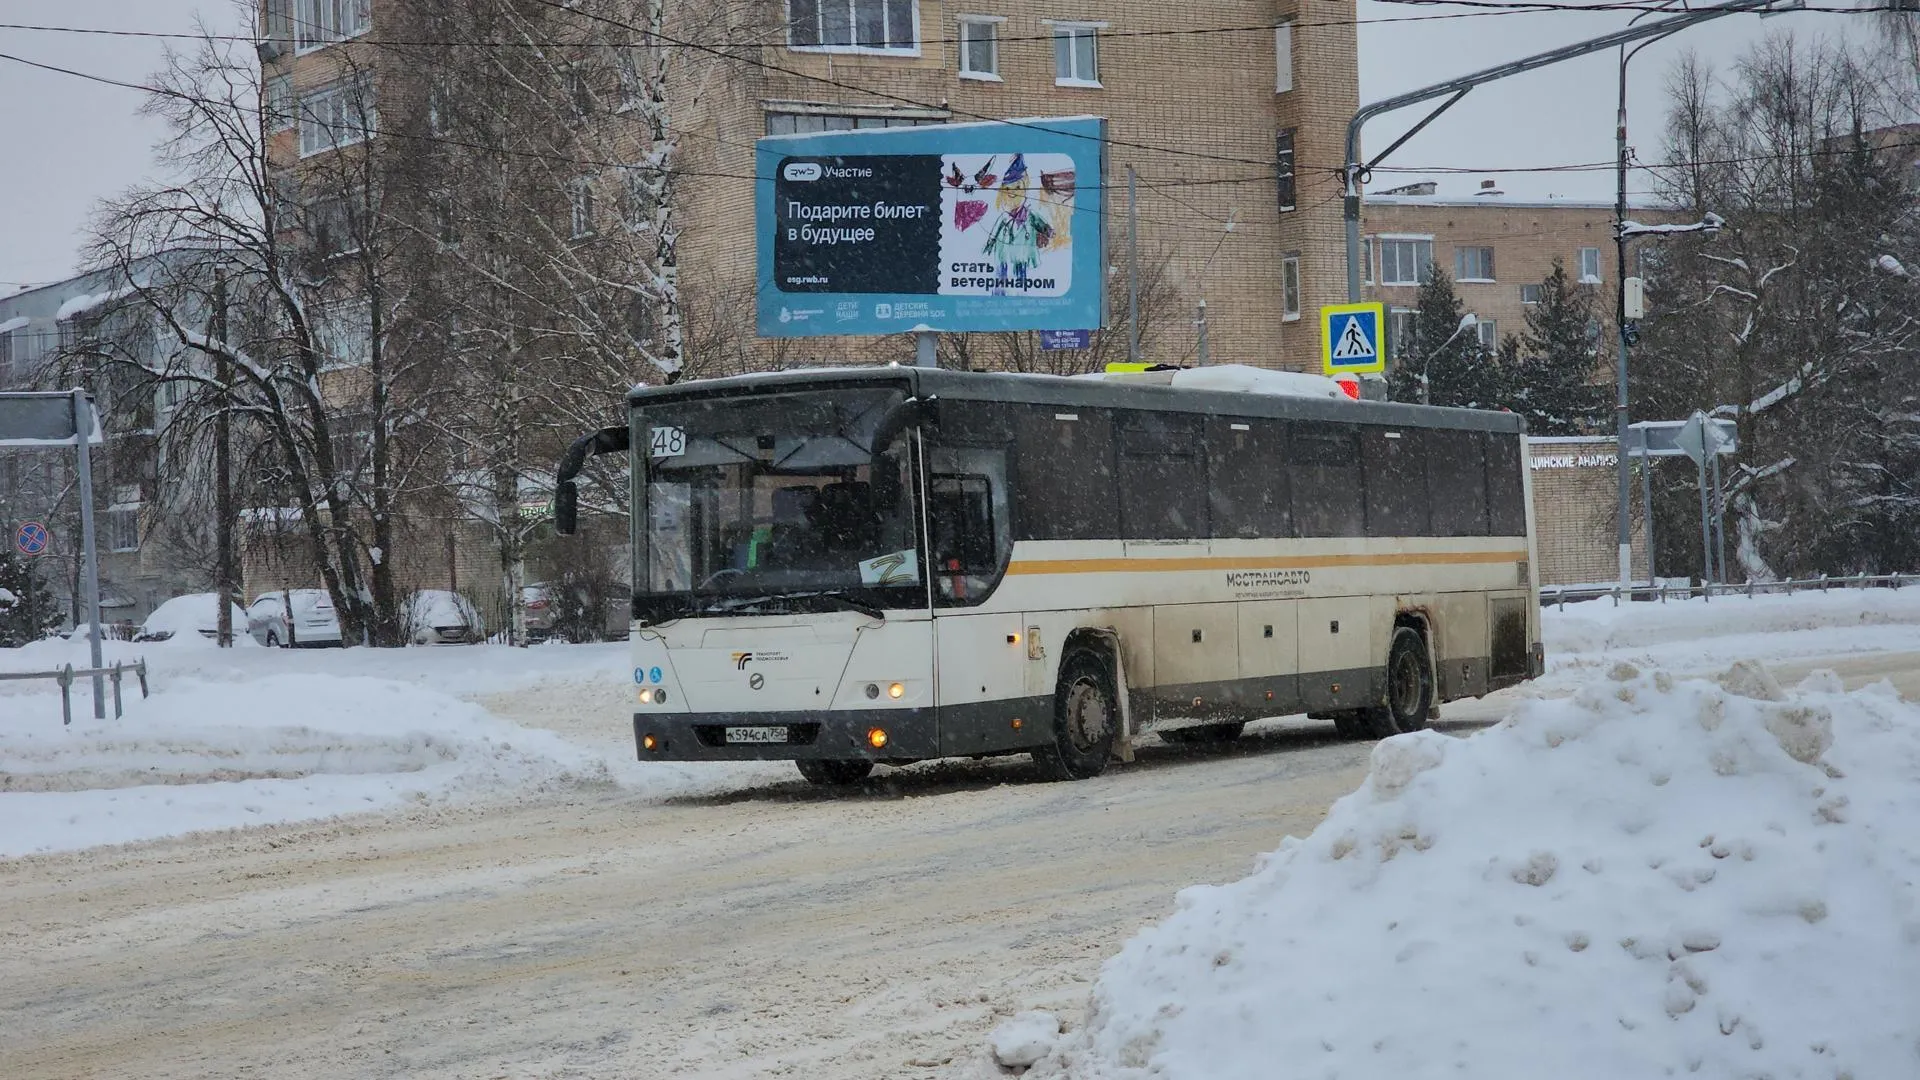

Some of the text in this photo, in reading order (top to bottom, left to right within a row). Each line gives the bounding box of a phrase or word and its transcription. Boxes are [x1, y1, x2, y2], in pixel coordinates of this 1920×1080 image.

[825, 166, 873, 178] Участие
[788, 201, 925, 223] Подарите билет
[788, 224, 875, 245] в будущее
[951, 262, 995, 273] стать
[787, 276, 828, 285] esg.rwb.ru
[951, 276, 1055, 291] ветеринаром
[837, 302, 859, 310] ДЕТИ
[894, 302, 929, 310] ДЕТСКИЕ
[653, 428, 682, 453] 48
[1226, 570, 1311, 588] МОСТРАНСАВТО
